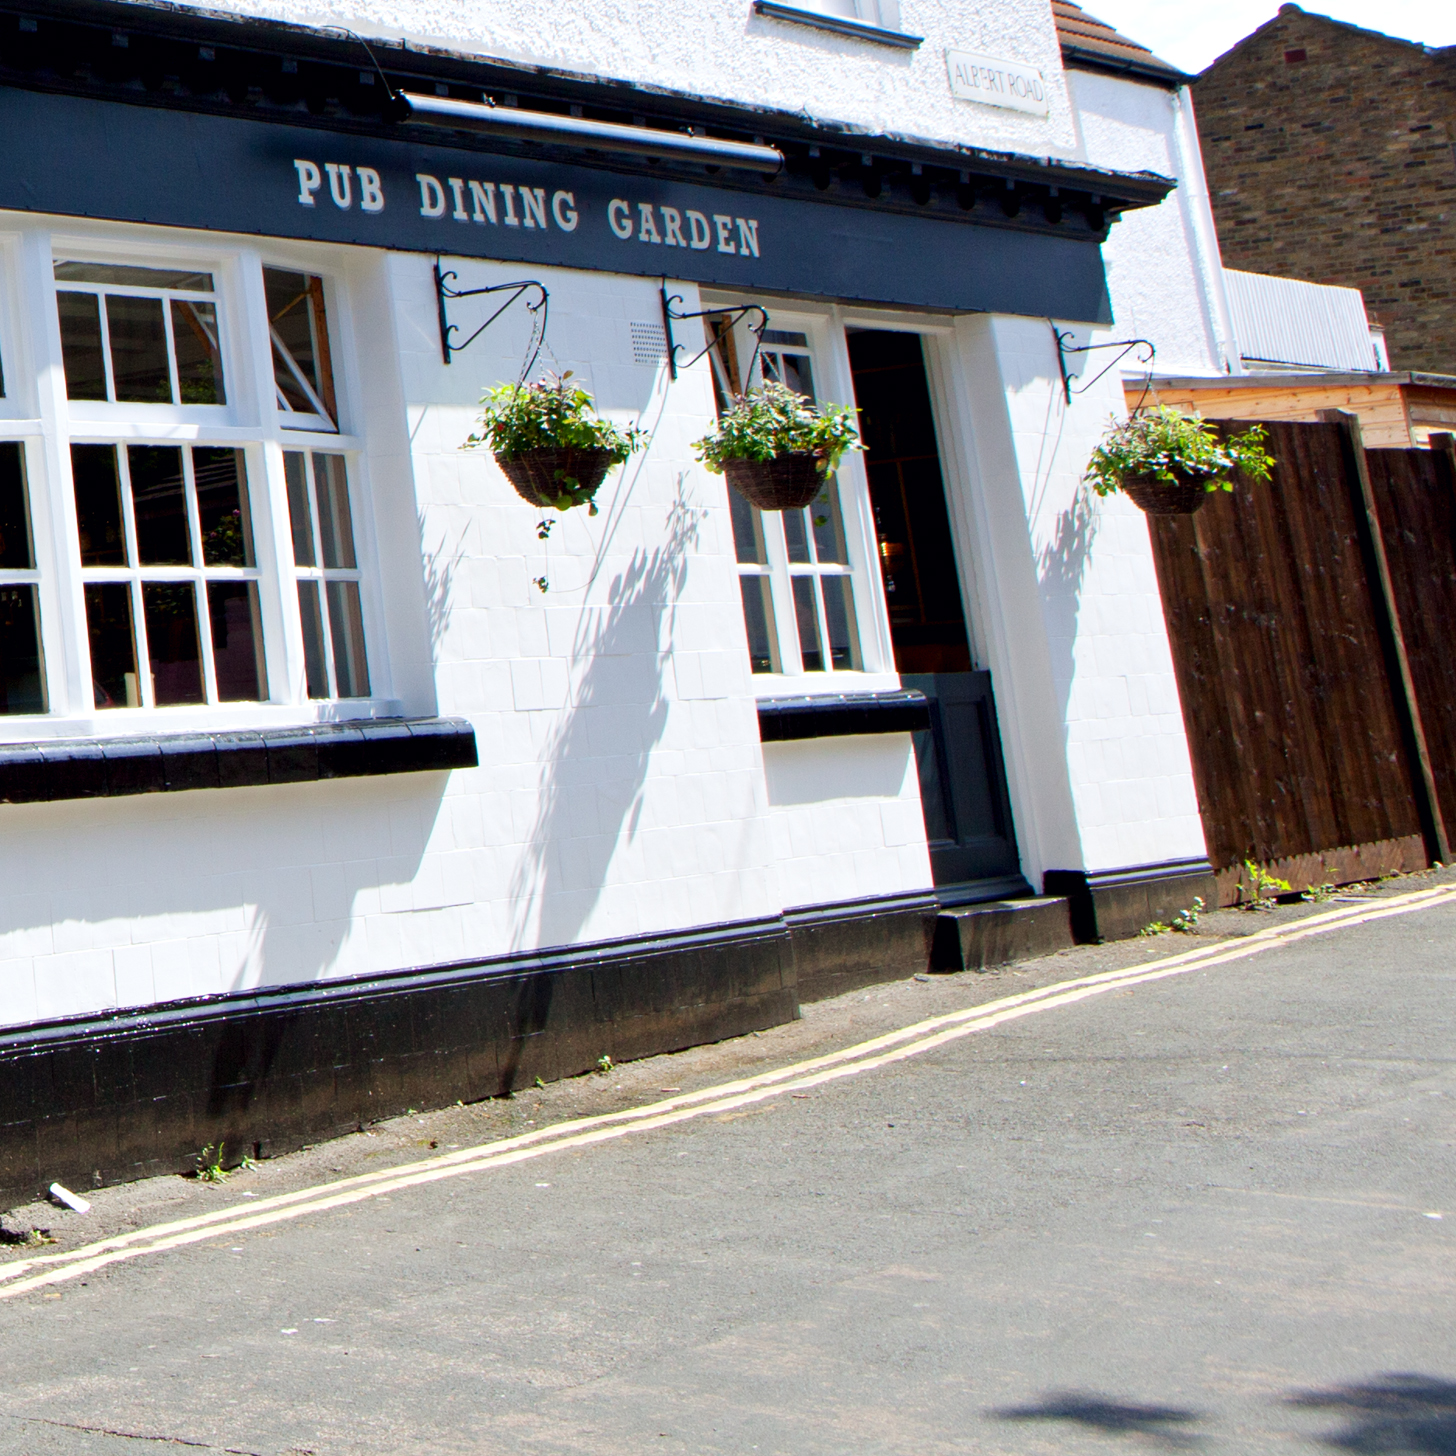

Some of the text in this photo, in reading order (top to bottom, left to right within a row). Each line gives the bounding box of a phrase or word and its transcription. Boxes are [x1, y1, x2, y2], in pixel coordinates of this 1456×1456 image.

[955, 63, 1044, 102] ALBERT ROAD
[293, 159, 761, 258] PUB DINING GARDEN
